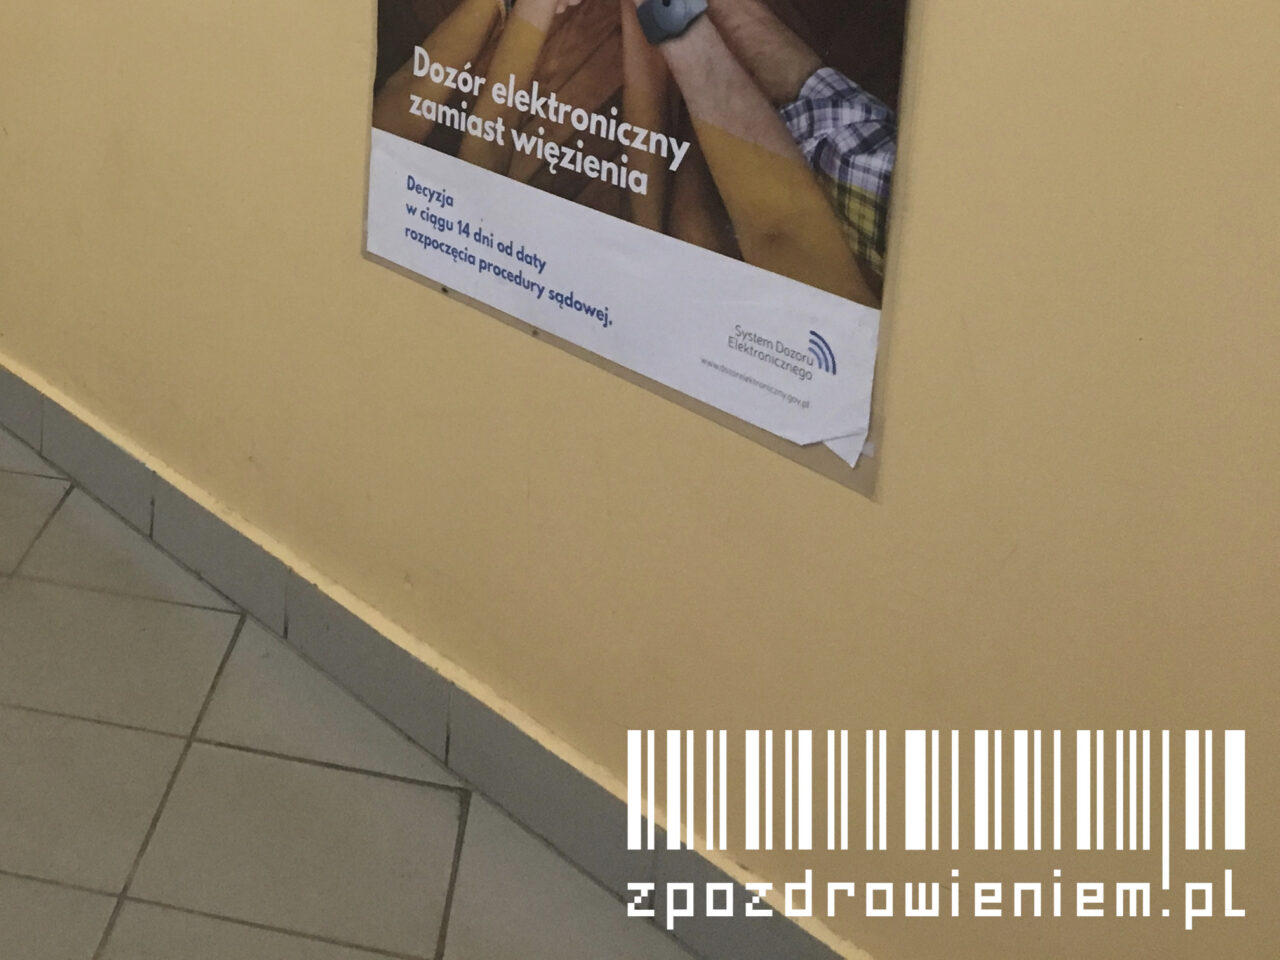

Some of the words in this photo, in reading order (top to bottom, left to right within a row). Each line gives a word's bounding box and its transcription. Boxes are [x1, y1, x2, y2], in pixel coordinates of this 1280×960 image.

[413, 45, 486, 96] Dozór
[491, 73, 691, 172] elektroniczny
[408, 94, 505, 145] zamiast
[511, 126, 648, 195] więzienia
[407, 175, 454, 208] Decyzja
[406, 203, 418, 216] w
[420, 207, 453, 232] ciągu
[457, 220, 470, 238] 14
[473, 227, 493, 248] dni
[497, 241, 513, 257] od
[516, 246, 547, 274] daty
[405, 226, 476, 265] rozpoczęcia
[478, 258, 545, 299] procedury
[548, 289, 613, 328] sądowej.
[728, 335, 813, 381] Elektronicznego
[735, 324, 774, 350] System
[775, 340, 814, 367] Dozoru
